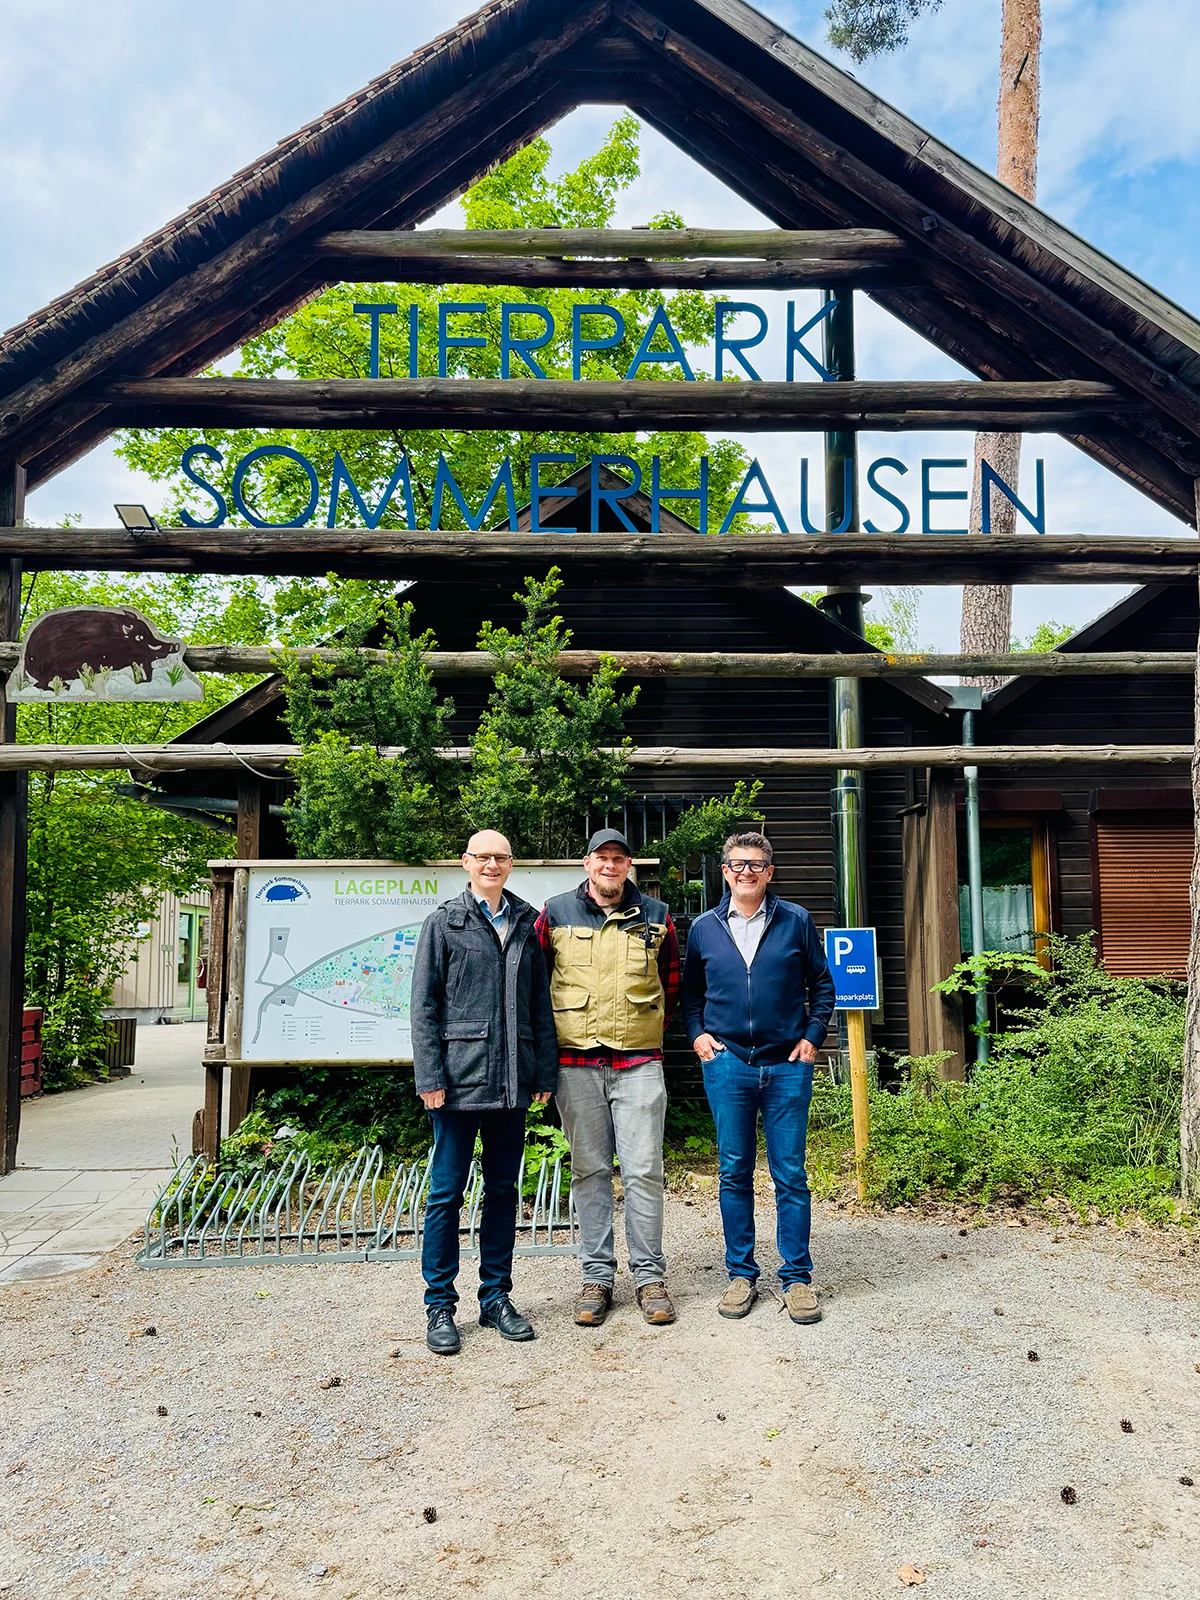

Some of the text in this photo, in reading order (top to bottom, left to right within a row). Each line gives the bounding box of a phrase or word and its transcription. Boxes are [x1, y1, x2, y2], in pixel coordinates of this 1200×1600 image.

[353, 300, 839, 382] TIERPARK
[180, 443, 1046, 535] SOMMERHAUSEN
[255, 876, 312, 899] Tierpark Sommerhausen
[334, 879, 438, 895] LAGEPLAN
[334, 898, 438, 906] TIERPARK SOMMERHAUSEN
[834, 937, 853, 965] P
